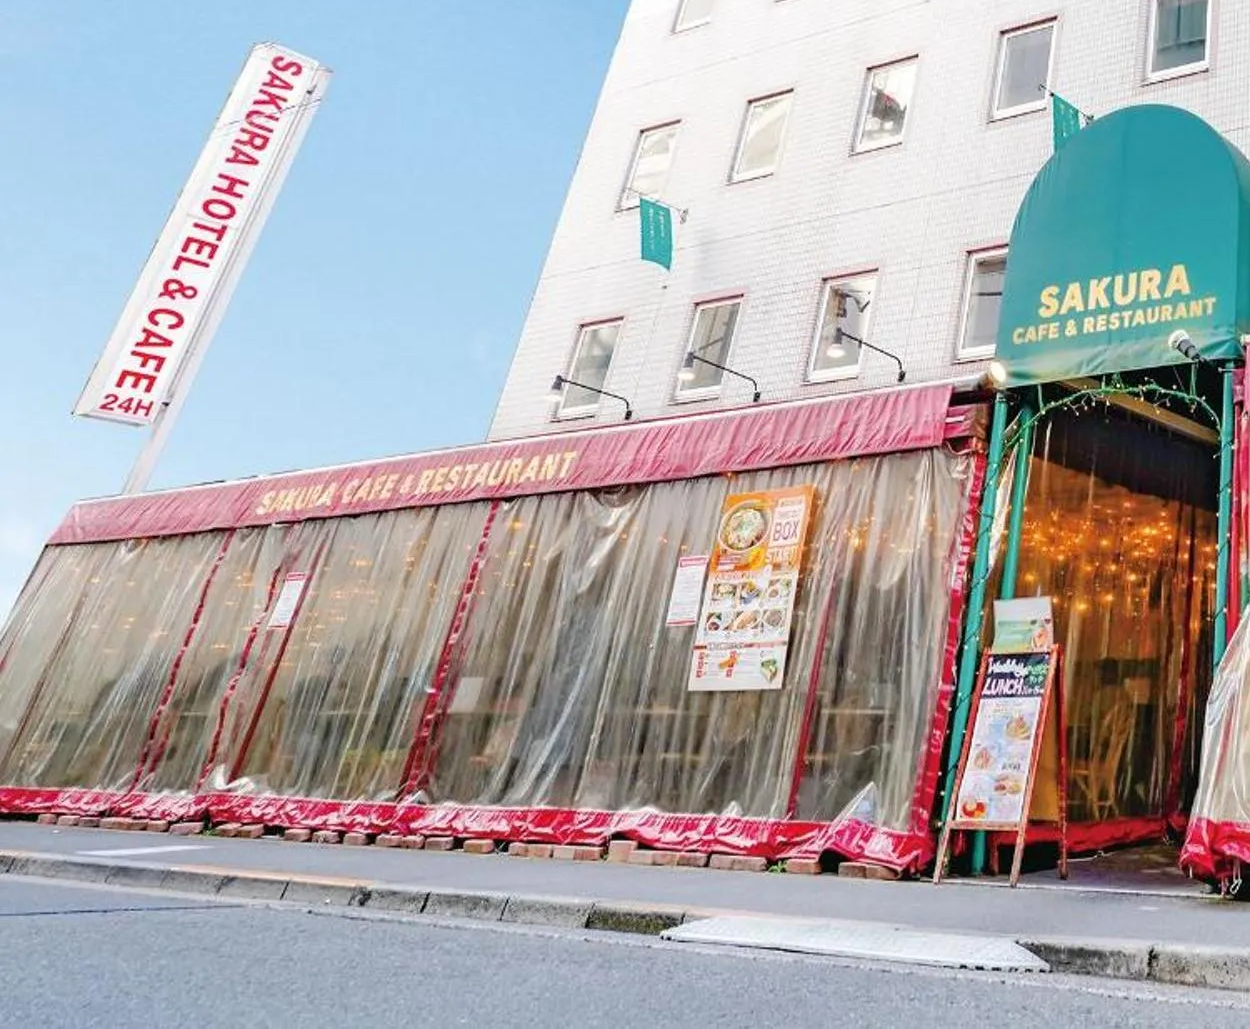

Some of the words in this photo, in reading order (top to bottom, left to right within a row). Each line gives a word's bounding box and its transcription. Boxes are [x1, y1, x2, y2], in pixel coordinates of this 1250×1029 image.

[225, 55, 303, 168] SAKURA
[172, 173, 250, 271] HOTEL
[158, 278, 198, 301] &
[1038, 264, 1191, 318] SAKURA
[1012, 322, 1060, 345] CAFE
[1064, 319, 1078, 337] &
[1083, 297, 1216, 334] RESTAURANT
[115, 308, 185, 394] CAFE
[99, 393, 155, 417] 24H
[256, 482, 333, 515] SAKURA
[341, 473, 401, 504] CAFE
[413, 451, 577, 496] RESTAURANT
[772, 520, 799, 542] BOX
[981, 676, 1024, 696] LUNCH
